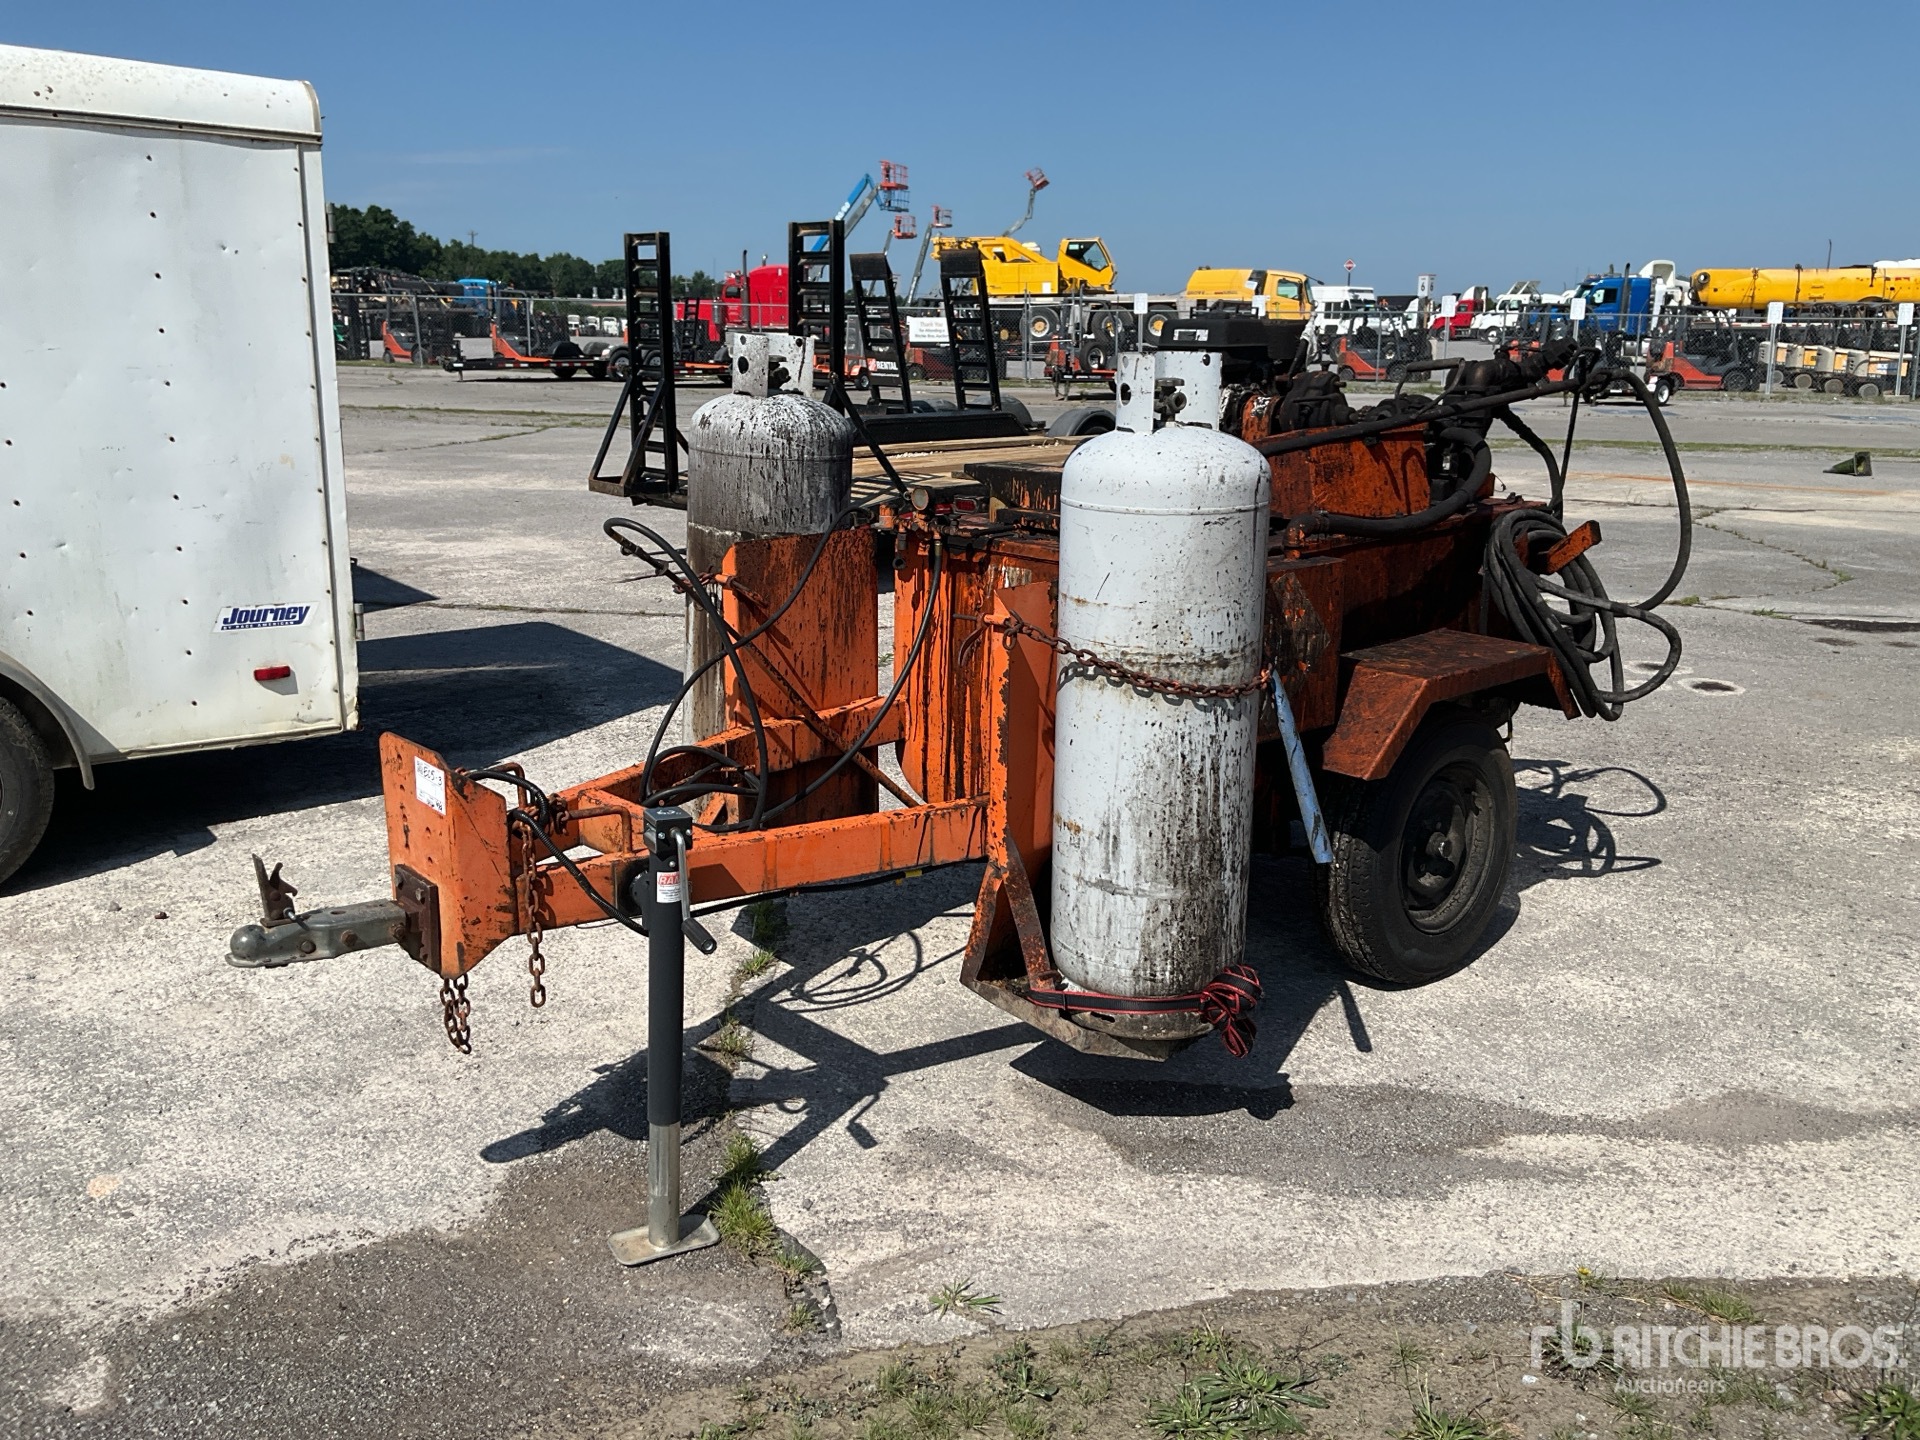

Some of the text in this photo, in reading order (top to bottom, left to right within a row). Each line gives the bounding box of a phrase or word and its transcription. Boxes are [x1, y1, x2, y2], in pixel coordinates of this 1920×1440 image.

[1421, 282, 1425, 291] 6
[876, 361, 898, 370] RENTAL
[222, 606, 311, 625] Journey
